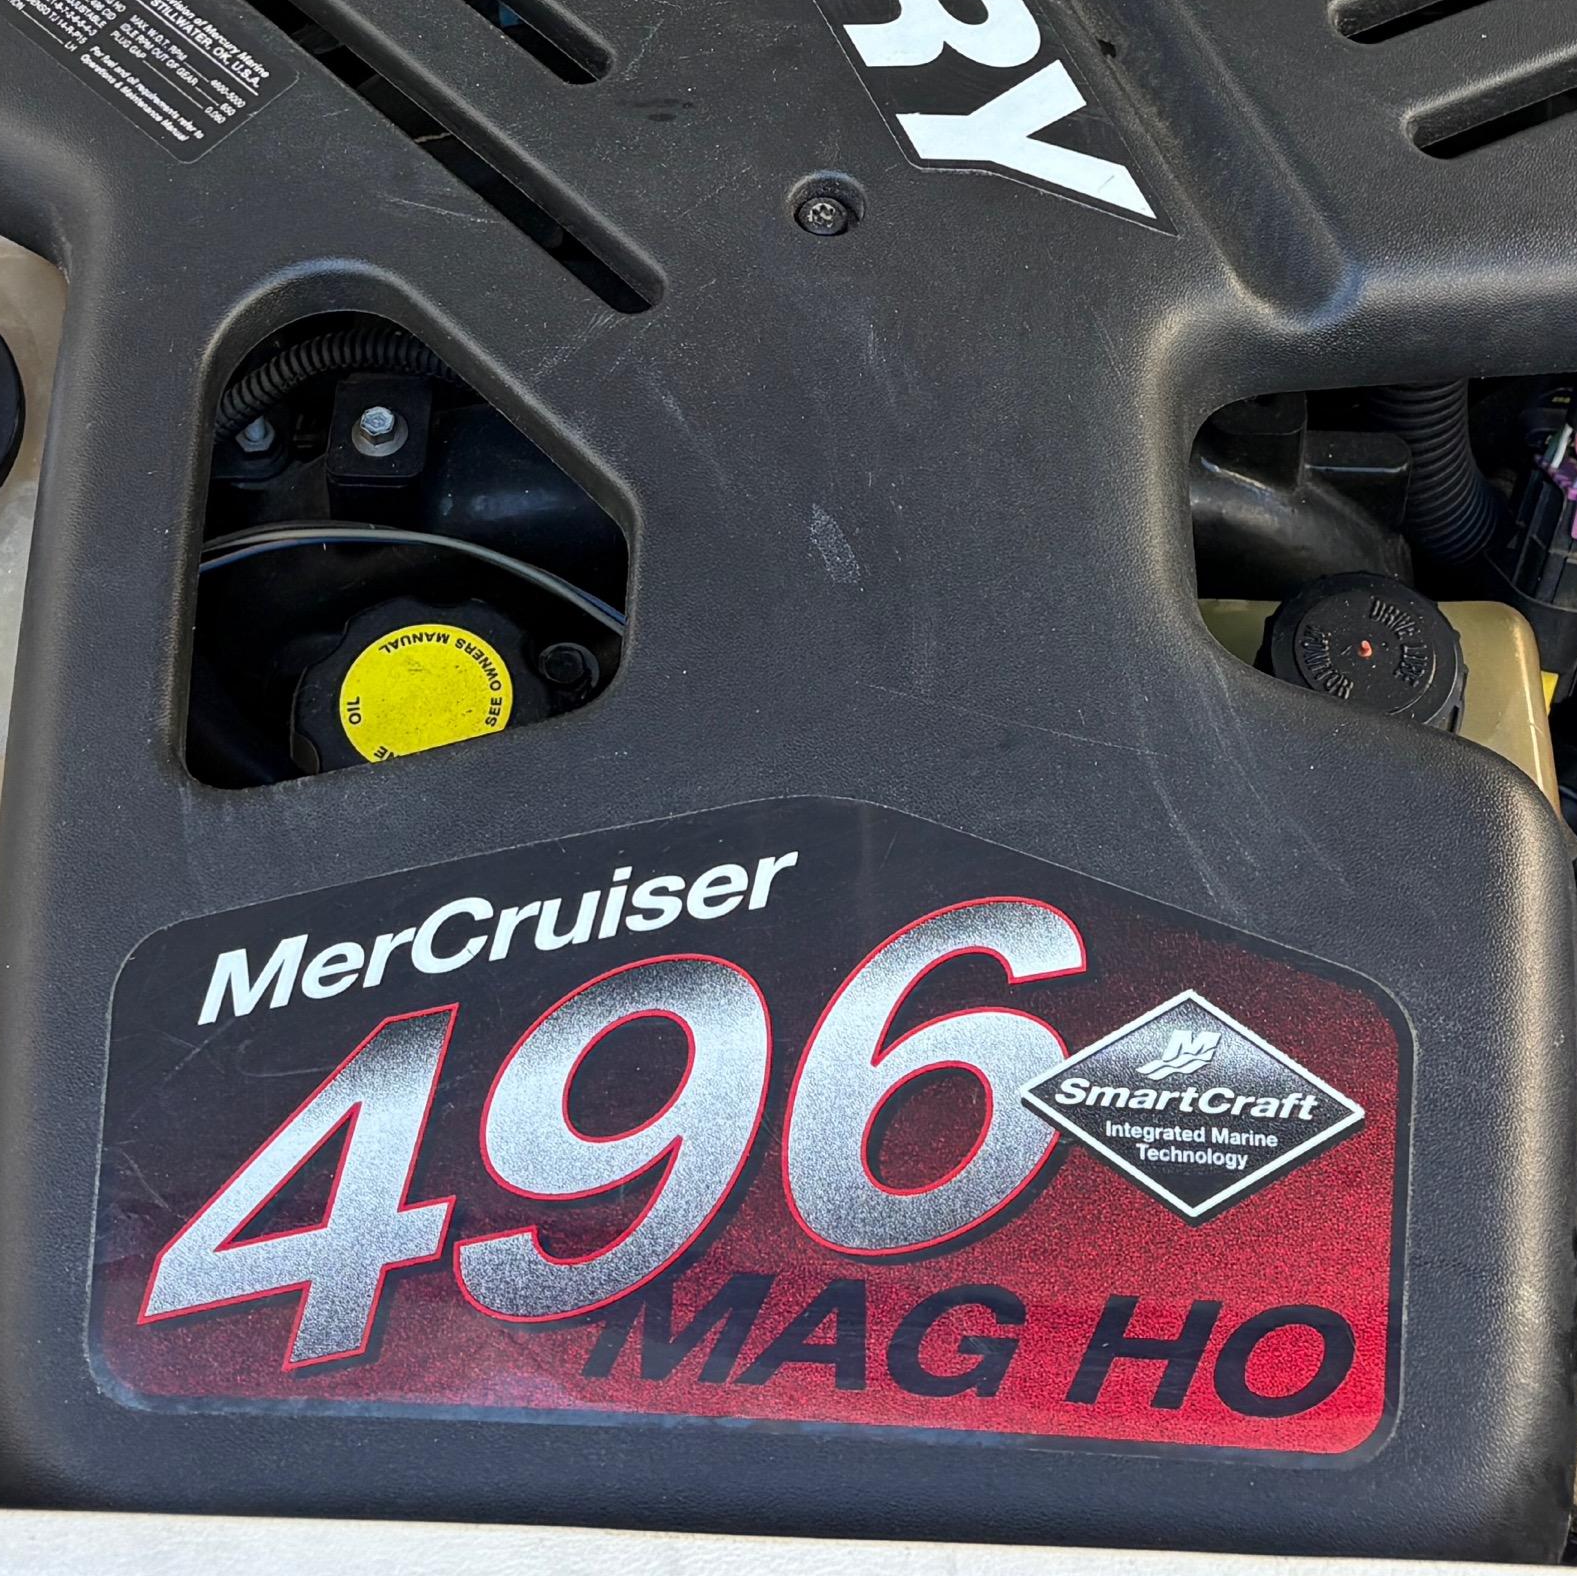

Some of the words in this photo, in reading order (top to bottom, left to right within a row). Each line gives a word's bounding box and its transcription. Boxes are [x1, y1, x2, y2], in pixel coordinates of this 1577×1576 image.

[110, 30, 132, 47] PLUG
[129, 45, 146, 59] GAP
[194, 16, 207, 27] of
[202, 24, 240, 54] Mercury
[237, 51, 270, 77] Marine
[151, 47, 168, 62] OUT
[165, 59, 179, 70] OF
[176, 68, 198, 85] GEAR
[378, 632, 451, 654] MANUAL
[455, 637, 502, 692] OWNERS
[346, 696, 362, 725] OIL
[485, 696, 503, 727] SEE
[196, 849, 800, 1026] MerCruiser
[1054, 1077, 1322, 1121] SmartCraft
[135, 896, 1088, 1372] 496
[1105, 1121, 1205, 1144] Integrated
[1211, 1128, 1279, 1148] Marine
[1135, 1143, 1249, 1170] Technology
[581, 1278, 1021, 1395] MAG
[1061, 1298, 1358, 1419] HO
